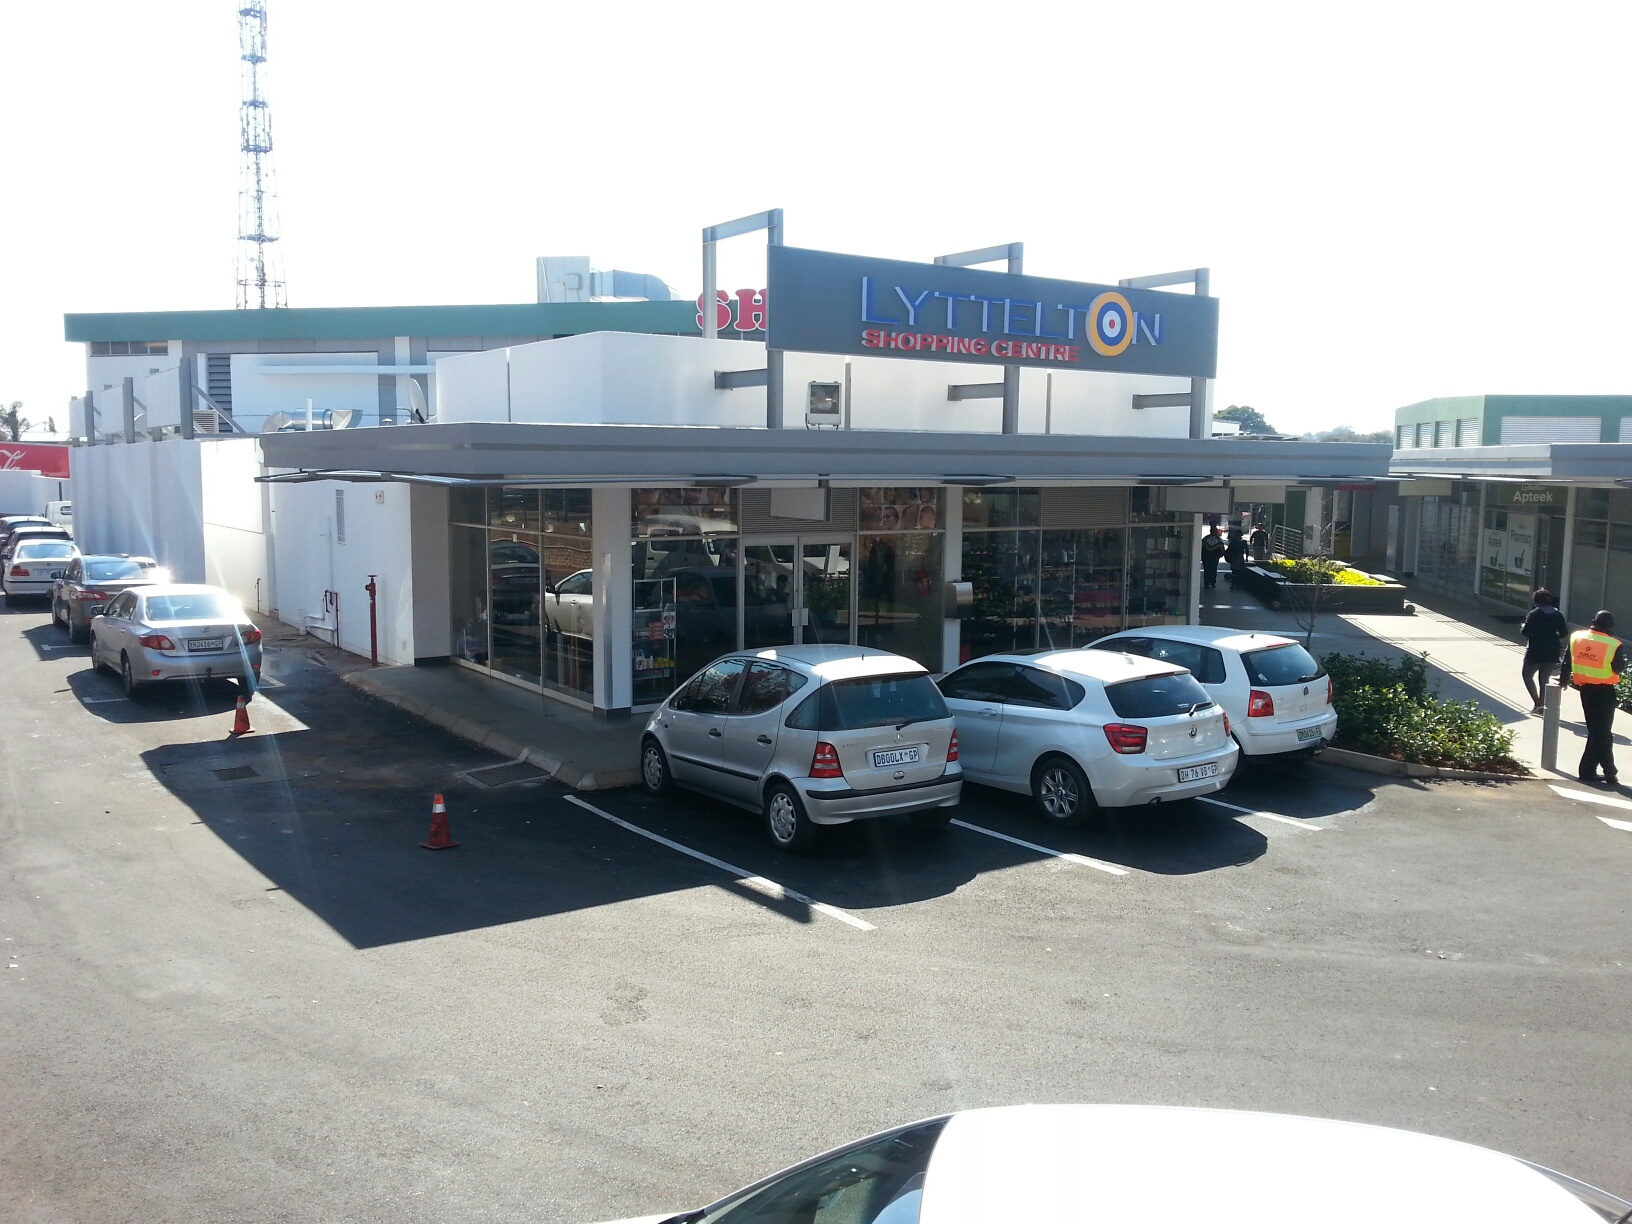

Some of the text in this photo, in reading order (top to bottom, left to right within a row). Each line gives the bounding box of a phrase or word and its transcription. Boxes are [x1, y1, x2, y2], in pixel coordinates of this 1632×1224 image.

[862, 276, 1163, 356] LYTTELTON
[861, 330, 1080, 361] SHOPPING CENTRE
[1513, 491, 1553, 503] Apteek
[909, 749, 918, 761] GP
